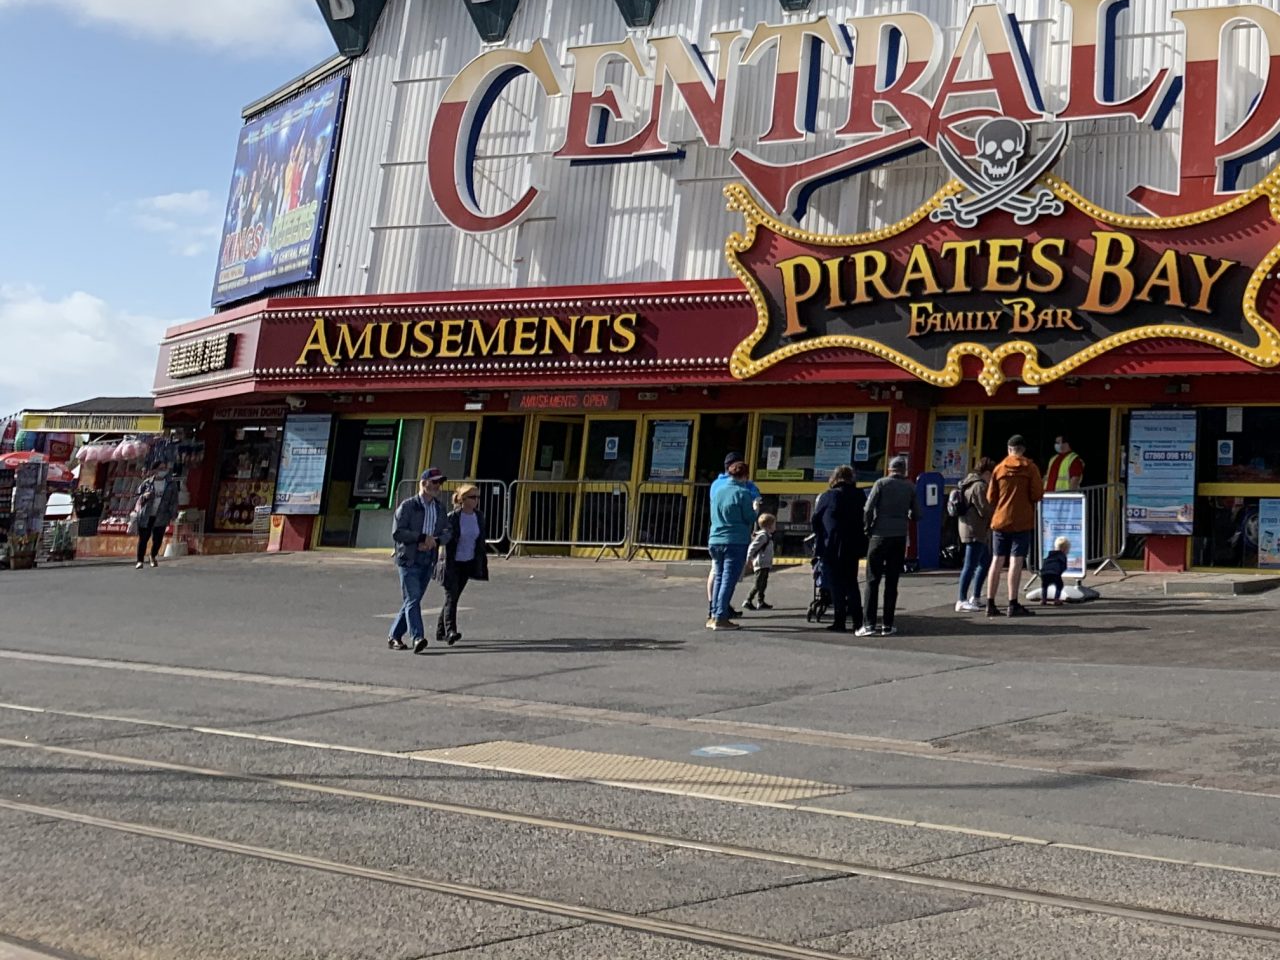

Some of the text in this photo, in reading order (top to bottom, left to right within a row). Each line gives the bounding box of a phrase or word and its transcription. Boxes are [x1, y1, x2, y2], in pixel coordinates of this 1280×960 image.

[775, 230, 1240, 337] PIRATES BAY
[296, 312, 639, 366] AMUSEMENTS
[582, 393, 609, 407] OPEN
